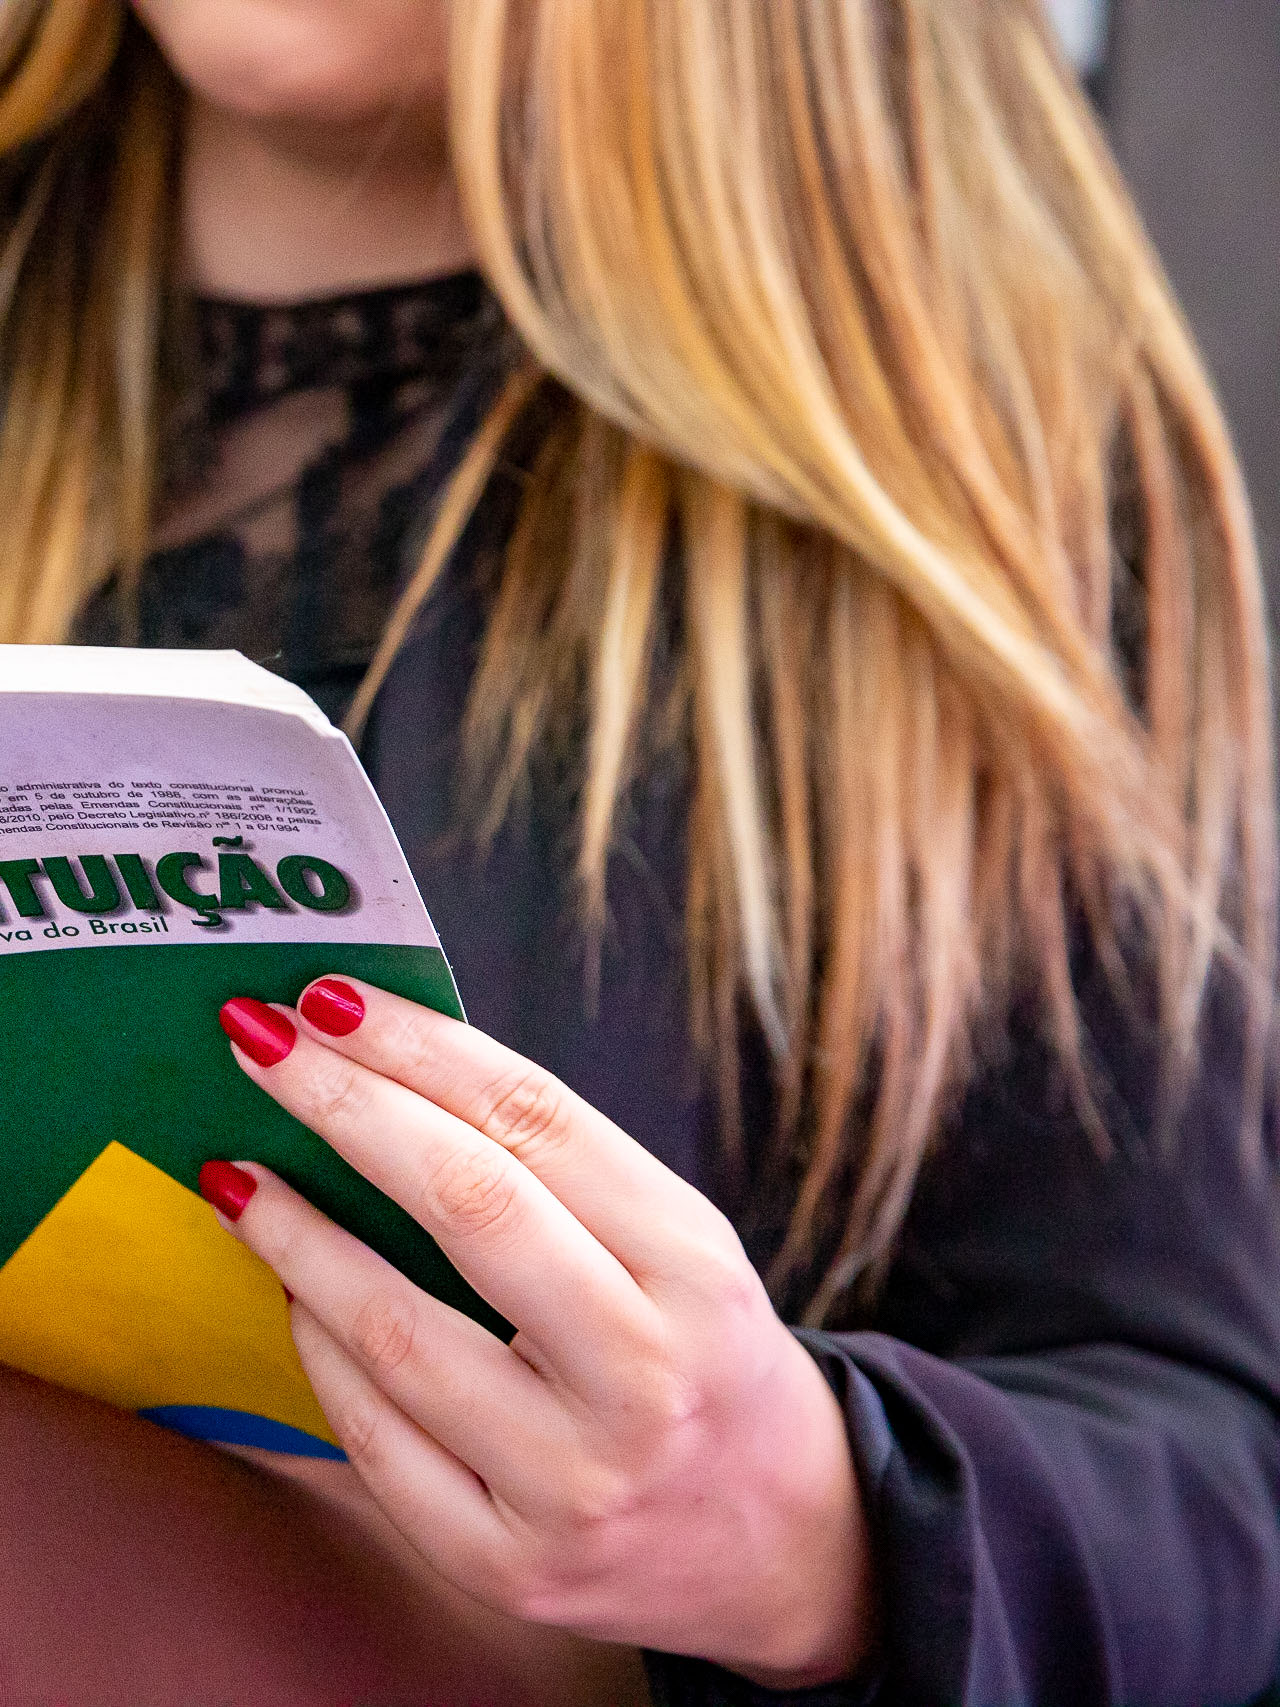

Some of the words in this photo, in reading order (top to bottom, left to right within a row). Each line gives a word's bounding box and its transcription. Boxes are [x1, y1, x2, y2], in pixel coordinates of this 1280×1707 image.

[16, 782, 101, 792] administrativa
[109, 781, 124, 789] do
[131, 781, 162, 789] texto
[169, 783, 254, 792] constitucional
[35, 792, 43, 800] 5
[50, 792, 66, 800] de
[72, 791, 120, 799] outubro
[127, 790, 143, 798] de
[192, 792, 219, 800] com
[249, 795, 313, 806] alterações
[40, 801, 73, 812] pelas
[81, 801, 140, 809] Emendas
[148, 800, 242, 811] Constitucionais
[275, 805, 317, 816] 1/1992
[48, 812, 75, 822] pelo
[77, 811, 127, 820] Decreto
[215, 812, 273, 822] 186/2008
[287, 817, 322, 826] pelas
[46, 821, 139, 831] Constitucionais
[162, 821, 212, 829] Revisão
[257, 823, 300, 832] 6/1994
[42, 920, 80, 939] do
[89, 916, 170, 935] Brasil
